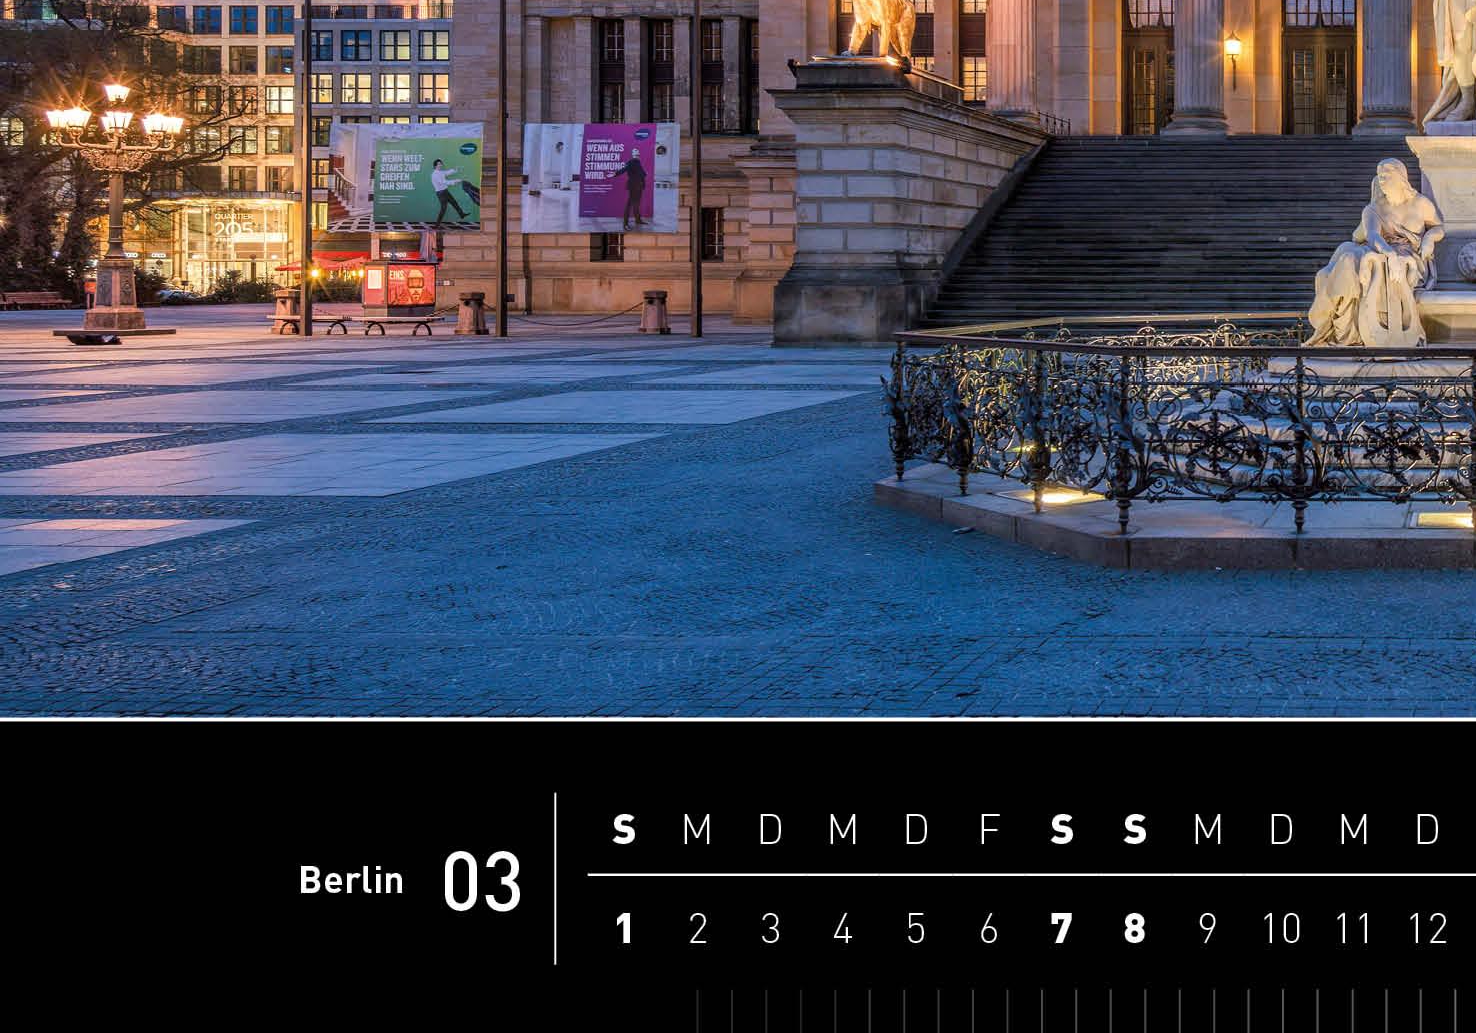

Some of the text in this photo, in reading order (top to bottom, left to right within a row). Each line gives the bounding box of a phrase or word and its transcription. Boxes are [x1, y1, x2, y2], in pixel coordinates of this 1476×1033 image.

[586, 143, 625, 152] WENN AUS
[585, 152, 620, 162] STIMMEN
[380, 181, 395, 191] NAH
[214, 221, 254, 237] 205
